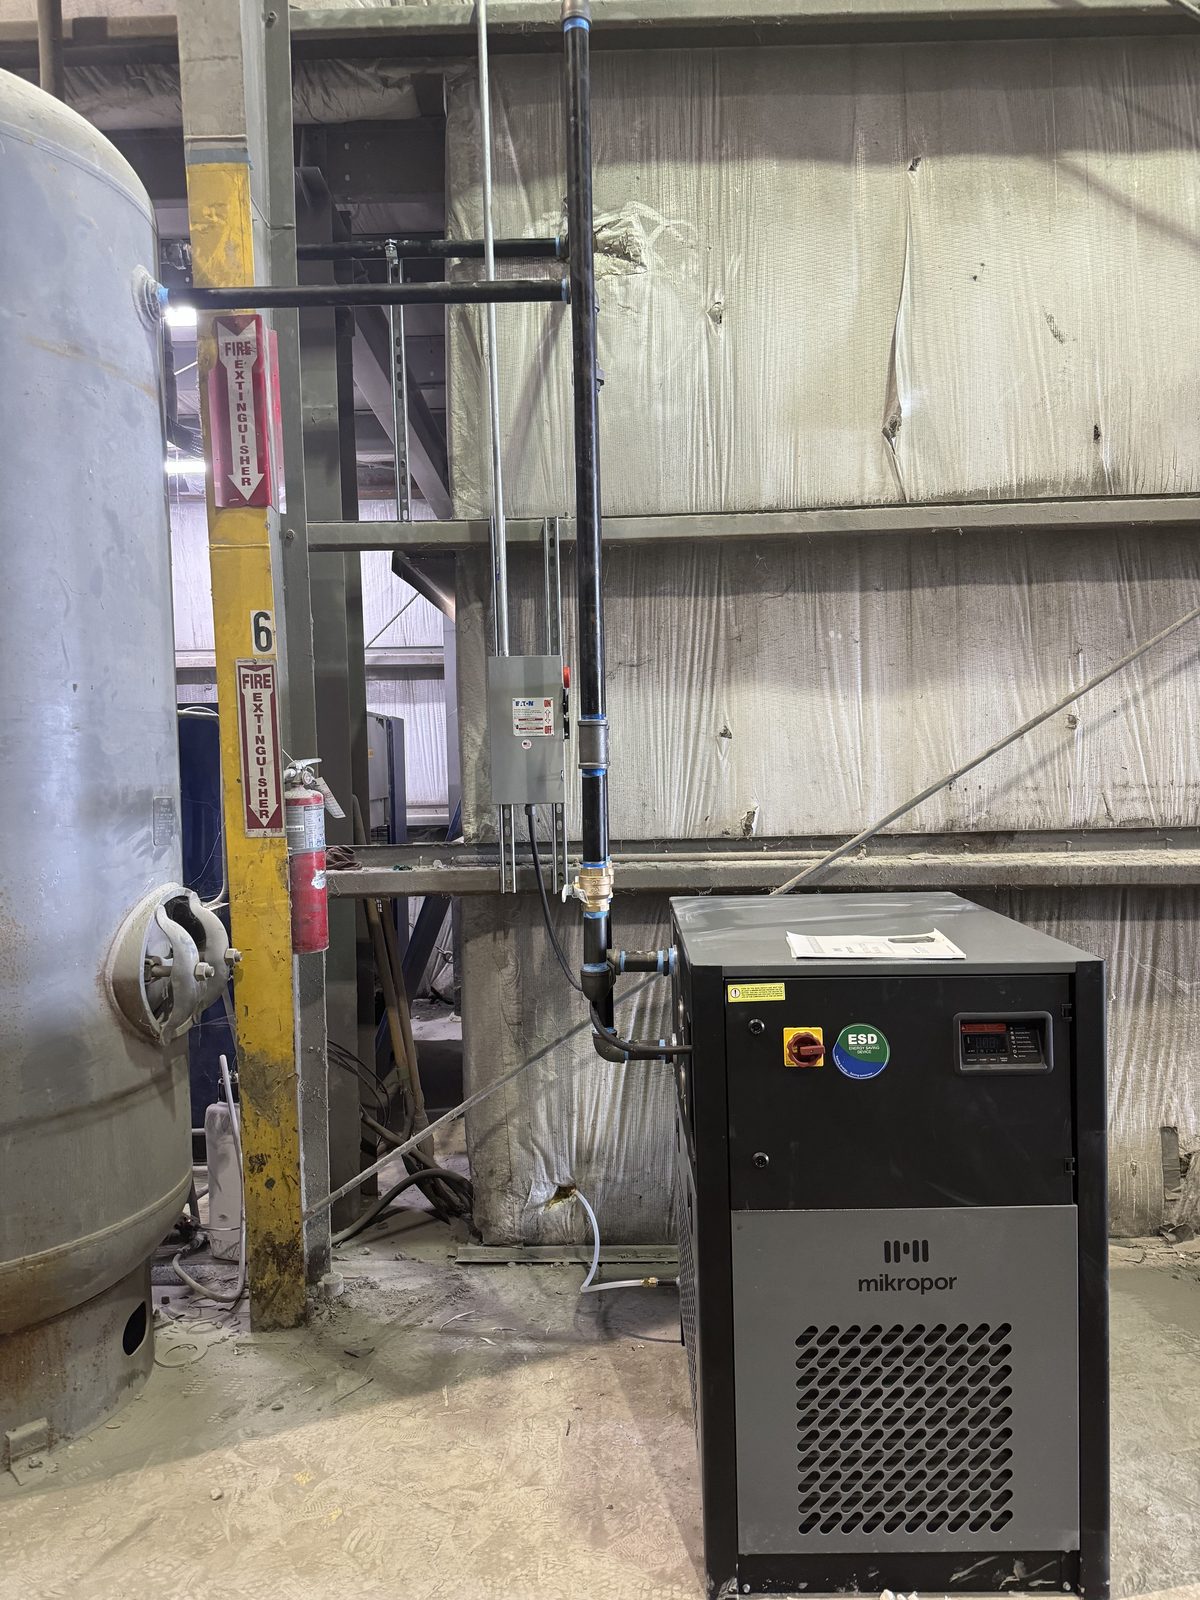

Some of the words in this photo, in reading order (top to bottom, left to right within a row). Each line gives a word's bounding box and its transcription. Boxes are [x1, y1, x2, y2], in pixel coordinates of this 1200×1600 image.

[224, 341, 252, 356] FIRE
[234, 359, 252, 487] EXTINGUISHER
[253, 611, 273, 652] 6
[242, 673, 272, 689] FIRE
[252, 692, 270, 819] EXTINGUISHER
[848, 1034, 877, 1044] ESD
[858, 1273, 958, 1295] mikropor
